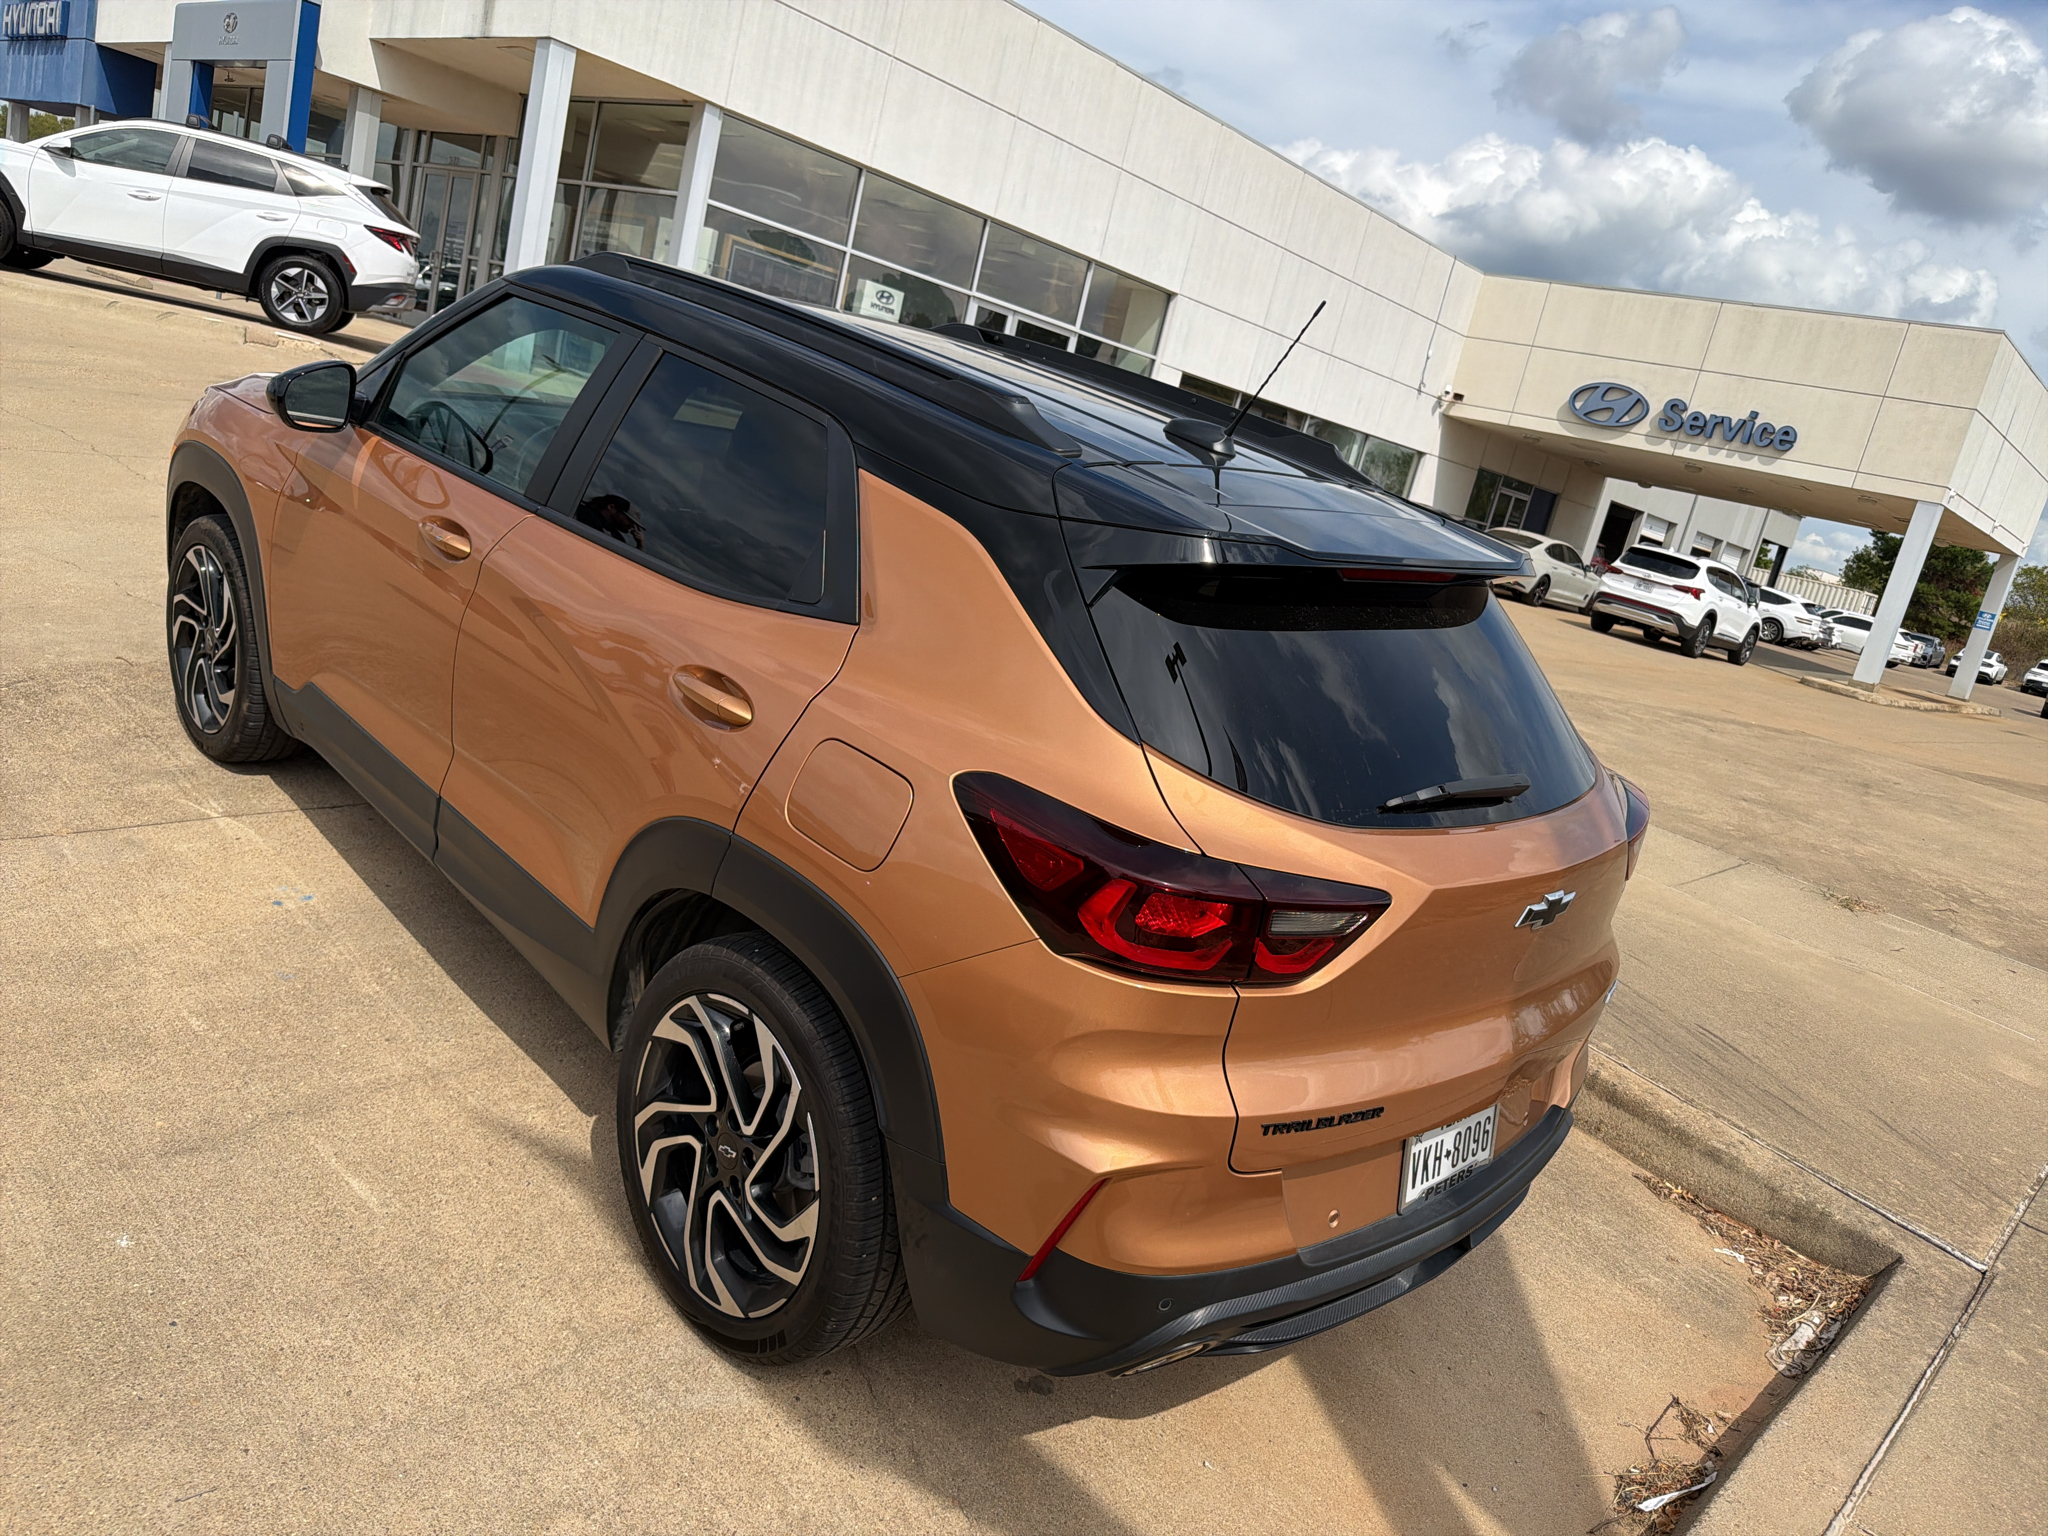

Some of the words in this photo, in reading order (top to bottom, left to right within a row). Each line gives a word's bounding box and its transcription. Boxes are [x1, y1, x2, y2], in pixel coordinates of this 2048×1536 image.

[3, 0, 62, 36] HYUNDAI
[1658, 398, 1797, 451] Service
[1261, 1106, 1384, 1136] TRAILBLAZER
[1424, 1164, 1474, 1201] PETERS
